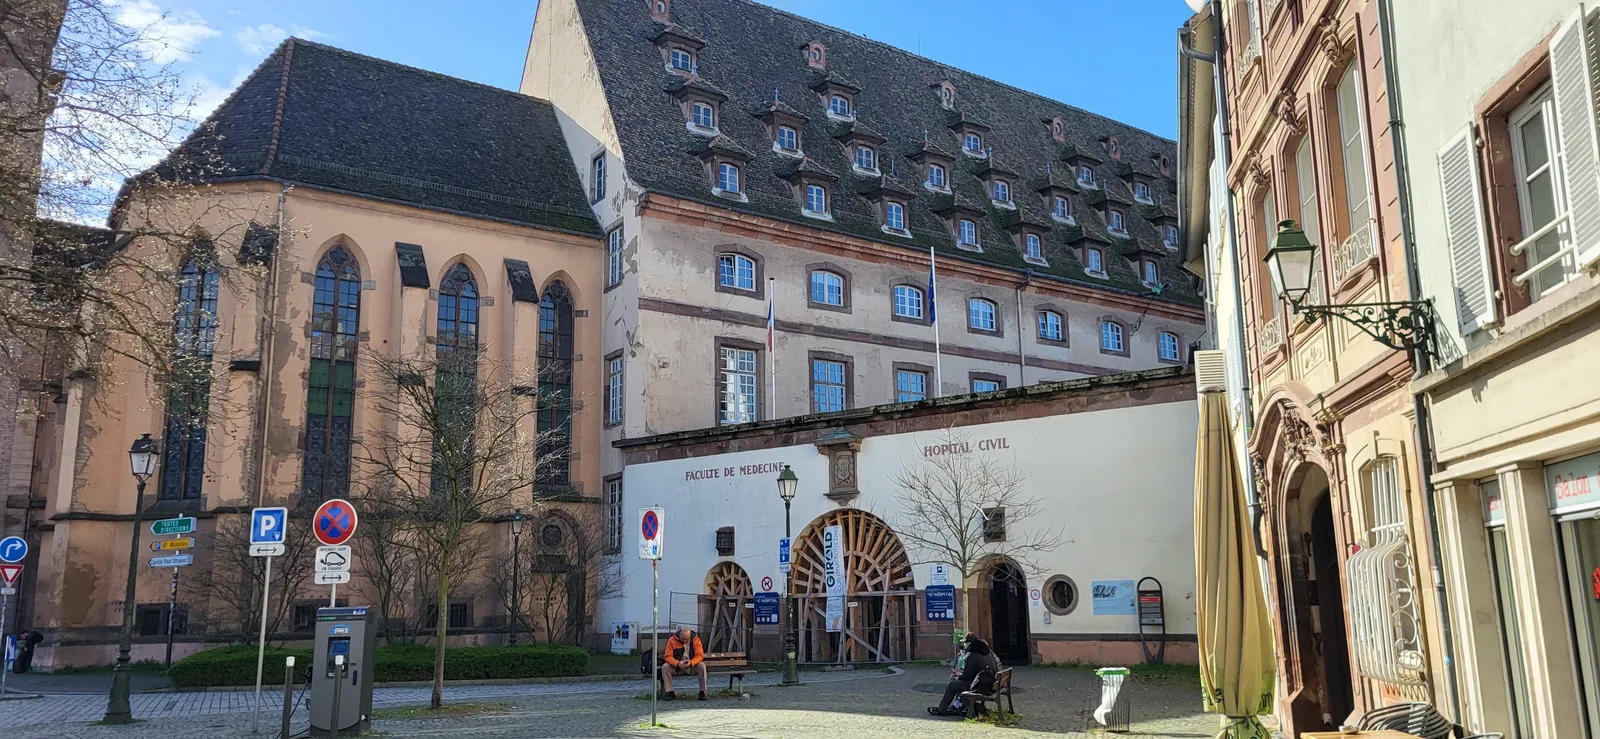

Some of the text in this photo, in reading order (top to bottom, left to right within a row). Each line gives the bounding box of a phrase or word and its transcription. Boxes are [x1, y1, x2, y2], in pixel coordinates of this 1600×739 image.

[924, 438, 1009, 457] HOPITAL CIVIL
[685, 462, 785, 481] FACULTE DE MEDECINE
[1555, 472, 1592, 500] Salon
[161, 525, 190, 533] DIRECTIONS
[261, 515, 276, 536] P
